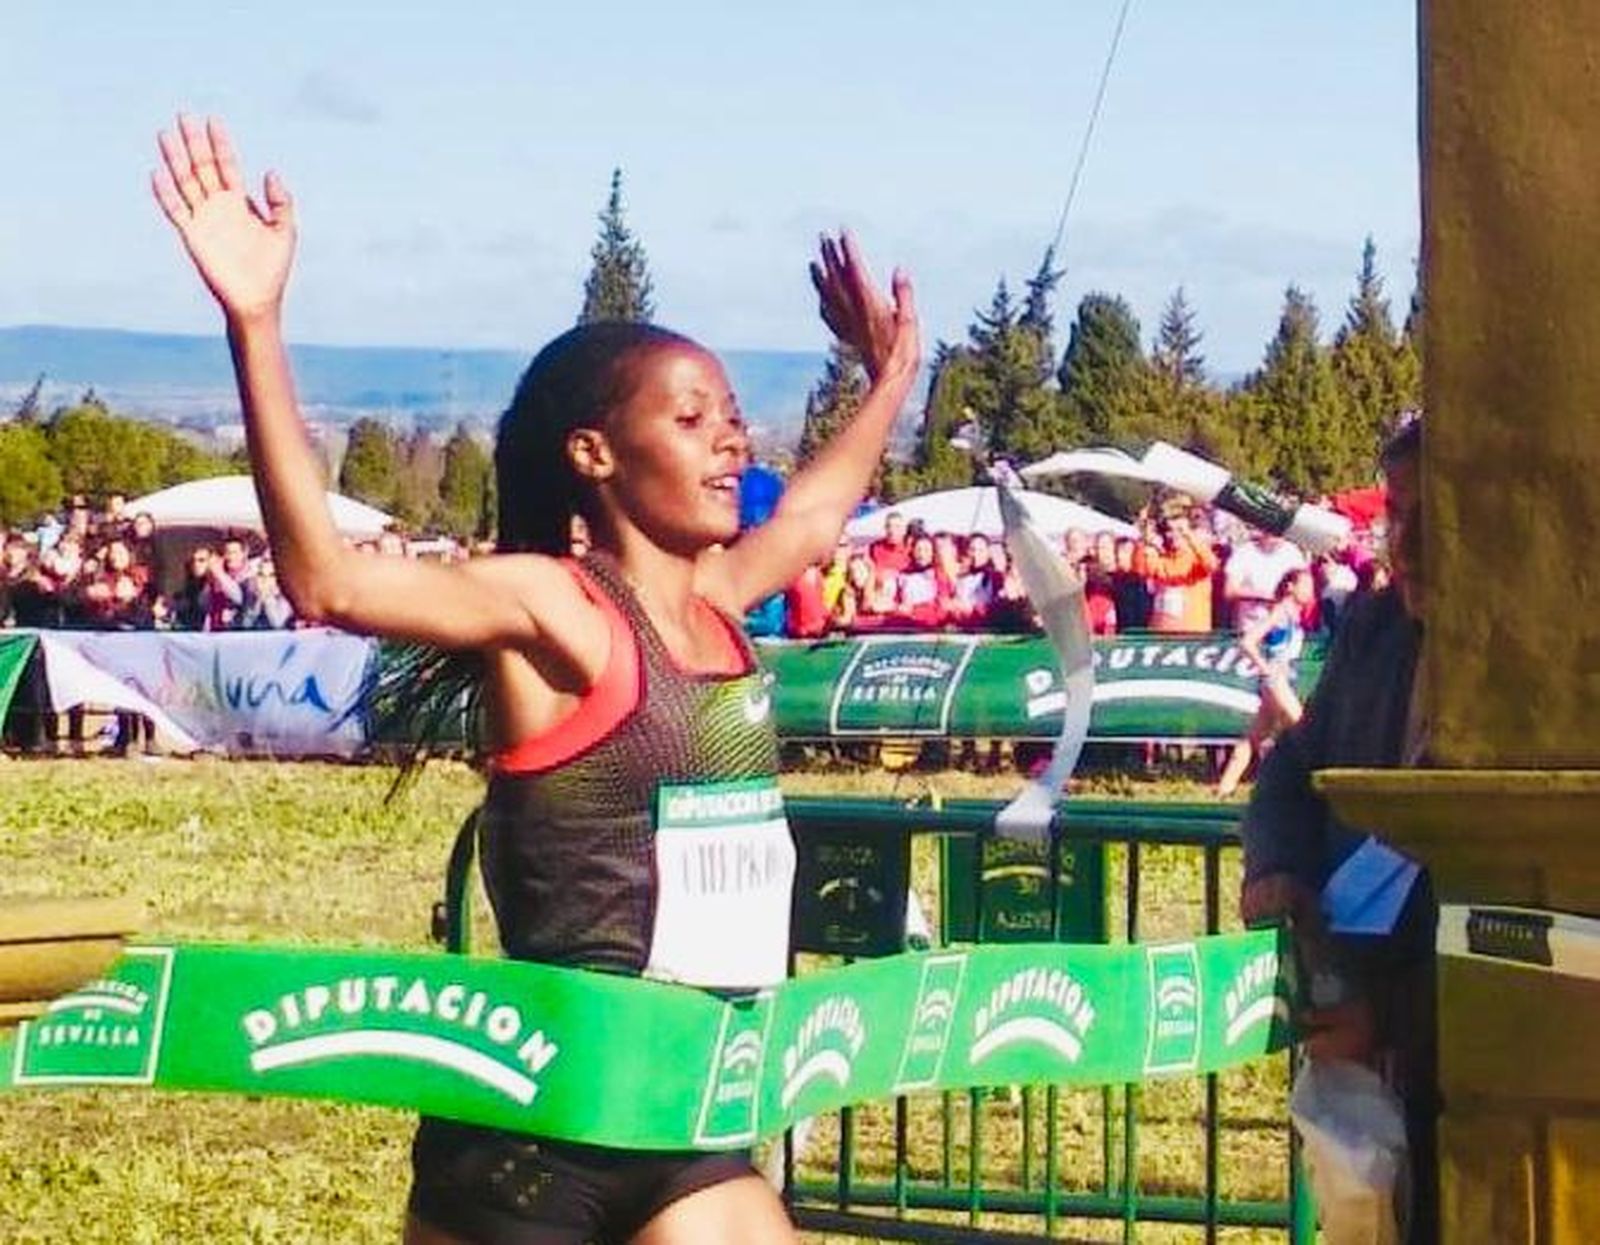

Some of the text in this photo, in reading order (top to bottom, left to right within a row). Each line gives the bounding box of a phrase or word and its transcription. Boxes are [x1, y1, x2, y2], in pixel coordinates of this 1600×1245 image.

[39, 1024, 140, 1046] SEVILLA
[243, 975, 558, 1073] DIPUTACION
[975, 967, 1095, 1039] DIPUTACION
